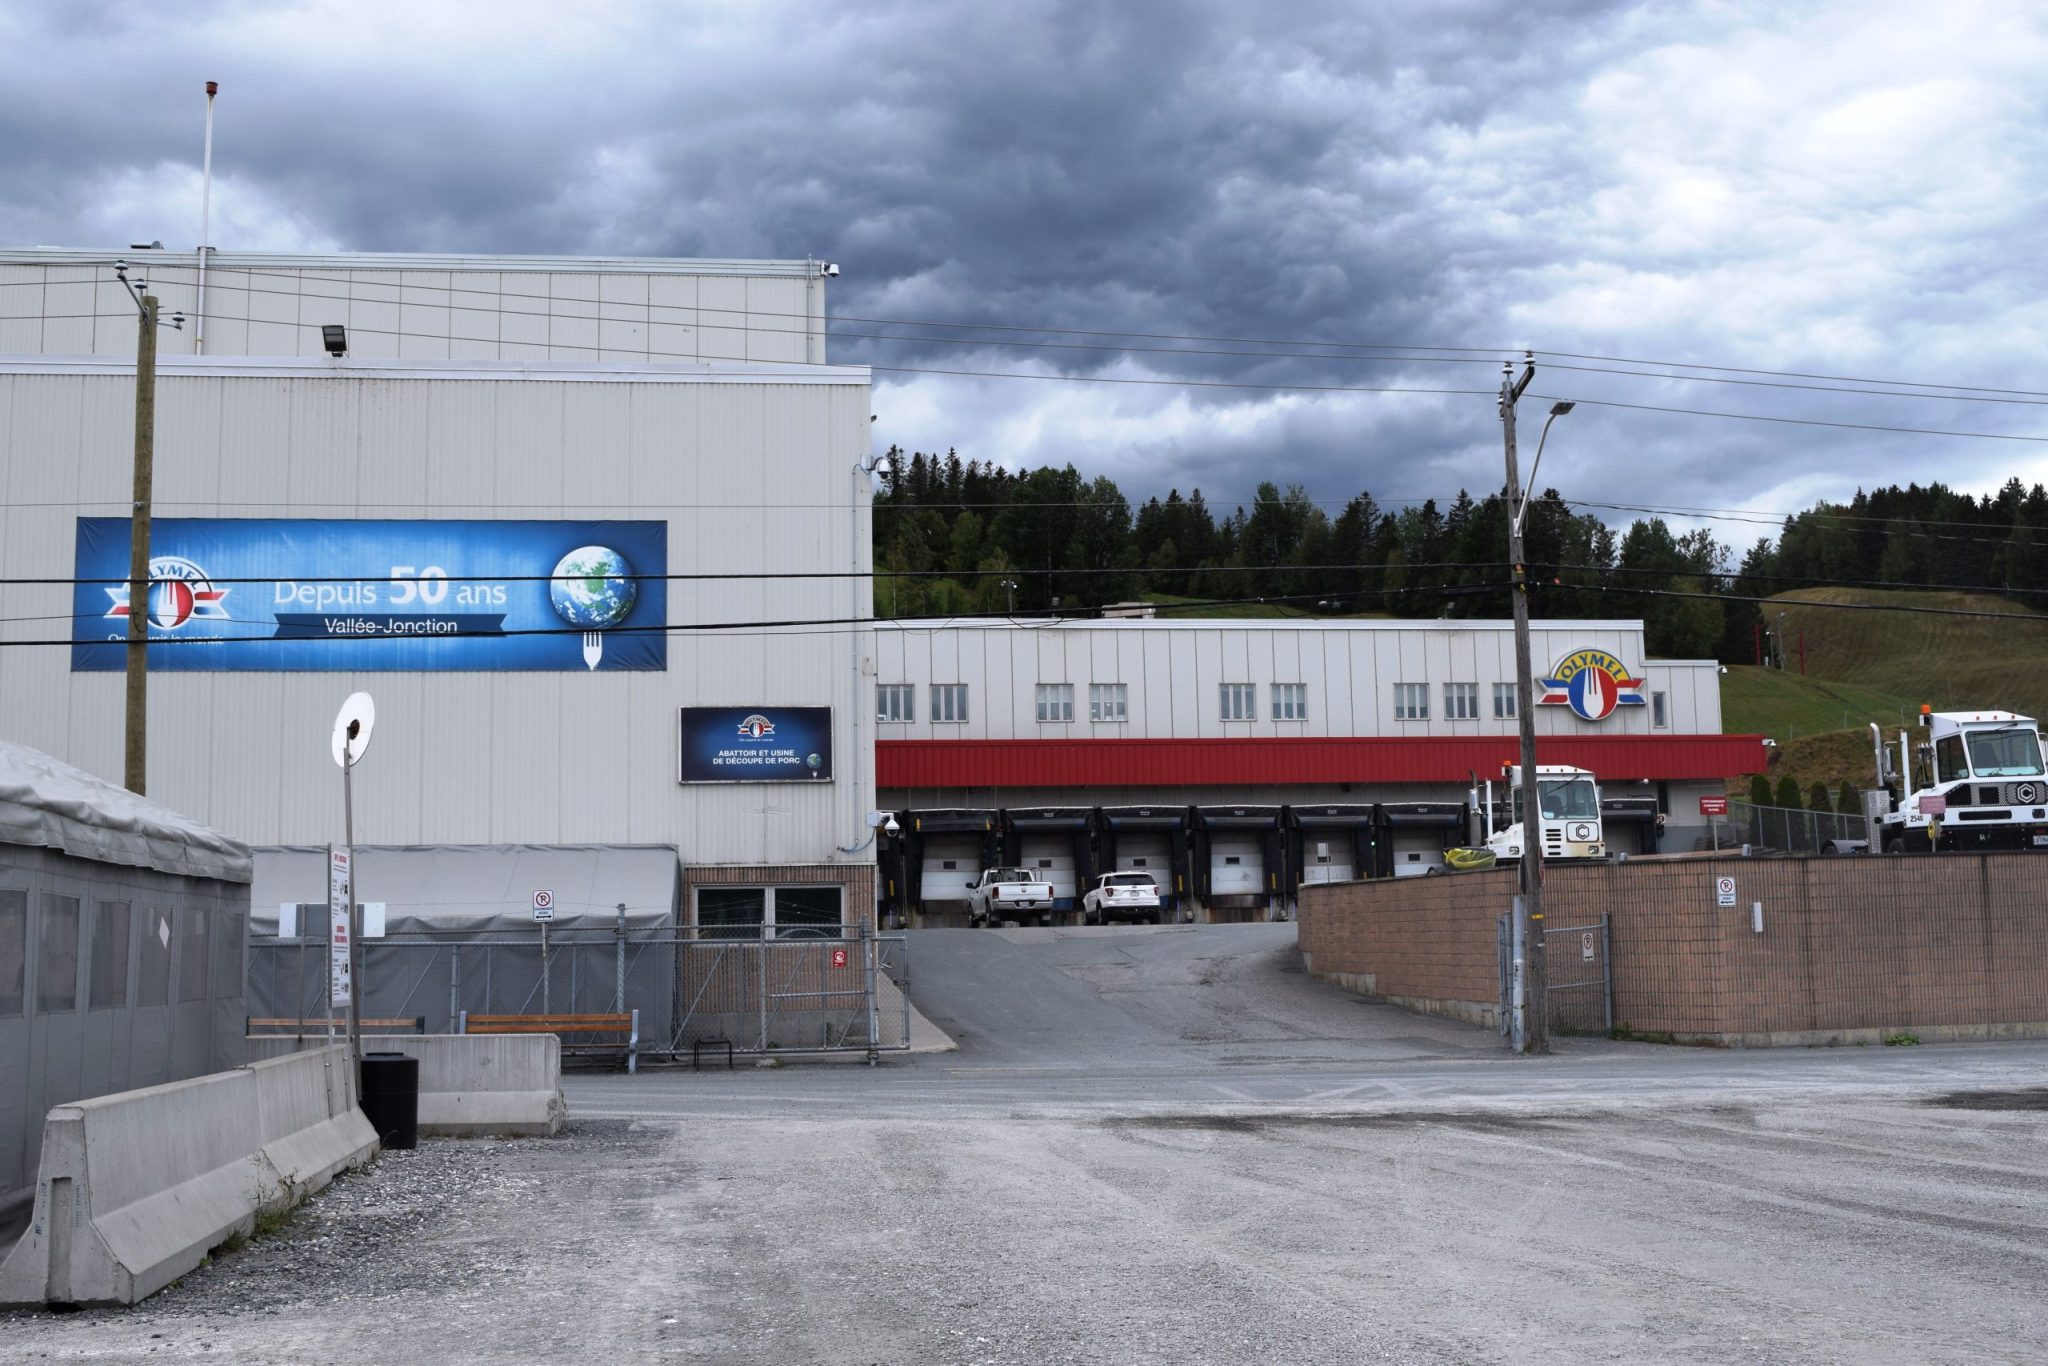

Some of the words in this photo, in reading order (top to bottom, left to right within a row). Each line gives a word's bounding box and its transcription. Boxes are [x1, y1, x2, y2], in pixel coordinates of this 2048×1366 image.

[148, 564, 197, 590] LYMEL
[274, 579, 377, 610] Depuis
[389, 566, 448, 604] 50
[456, 584, 507, 604] ans
[324, 617, 458, 634] Vallée-Jonction
[1561, 653, 1624, 680] OLYMEL
[725, 757, 763, 765] DÉCOUPE
